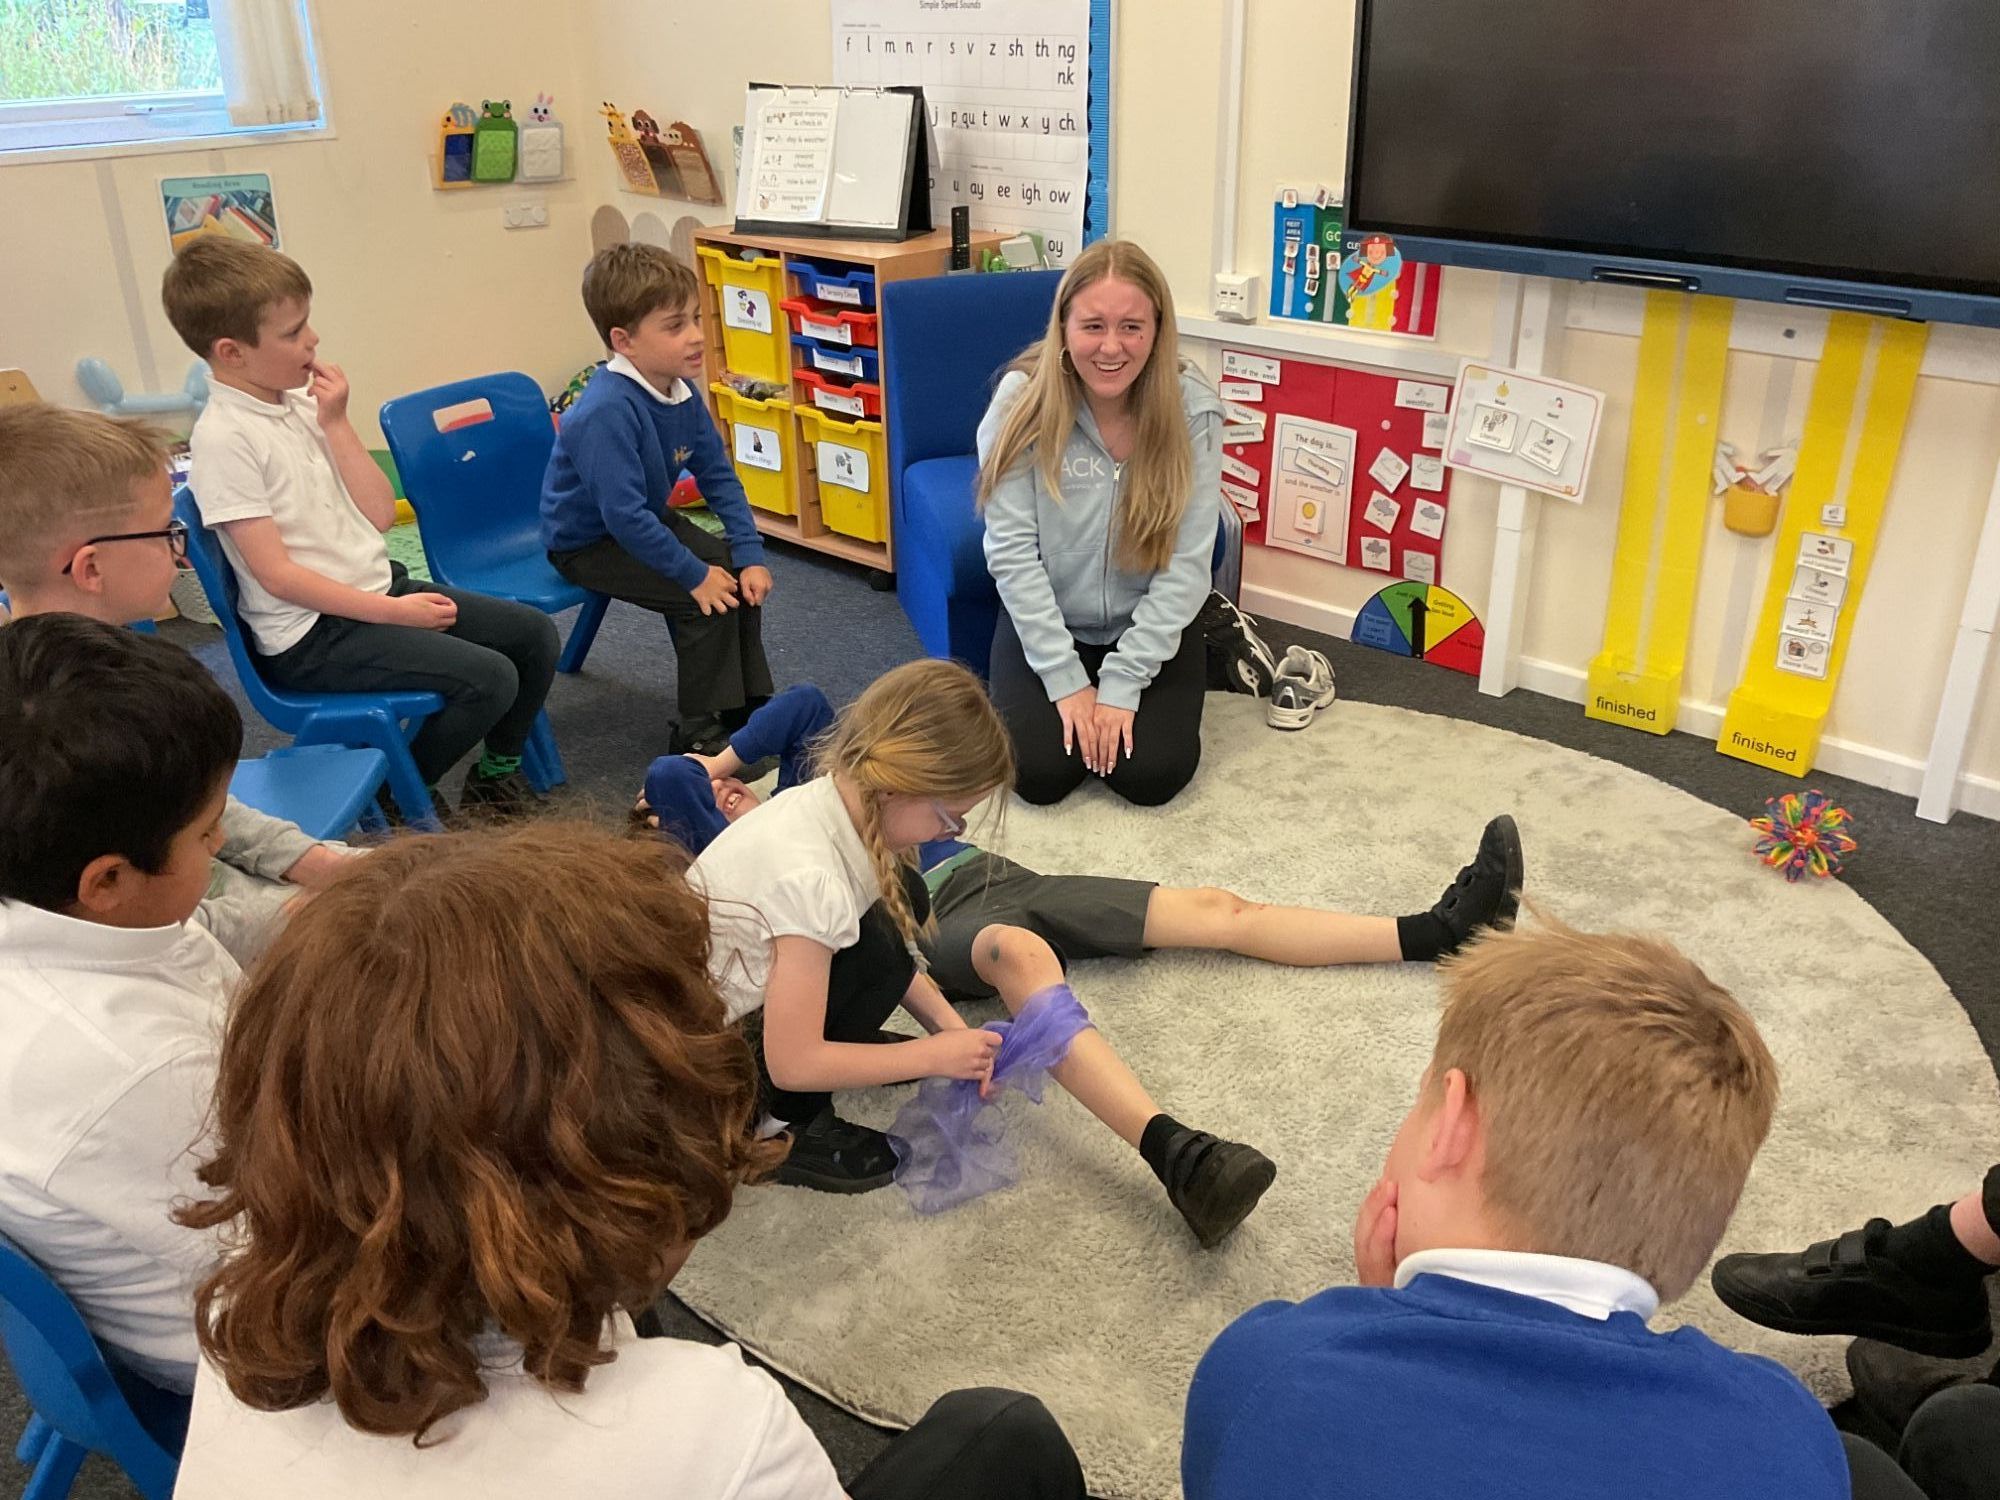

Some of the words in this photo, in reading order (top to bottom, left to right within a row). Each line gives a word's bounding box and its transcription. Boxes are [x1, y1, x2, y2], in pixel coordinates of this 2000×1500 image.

[846, 36, 851, 52] f
[886, 41, 896, 53] m
[906, 41, 913, 54] n
[928, 42, 933, 54] r
[950, 41, 955, 54] s
[967, 42, 975, 55] v
[990, 42, 996, 56] z
[1009, 38, 1024, 57] sh
[1036, 38, 1049, 57] th
[1058, 43, 1076, 63] ng
[1058, 66, 1074, 85] nk
[932, 106, 938, 127] j
[951, 111, 957, 127] p
[962, 112, 975, 129] qu
[982, 111, 988, 126] t
[999, 114, 1010, 127] w
[1021, 116, 1029, 128] x
[1042, 118, 1050, 134] y
[1059, 113, 1076, 131] ch
[953, 180, 959, 192] u
[970, 182, 984, 200] ay
[997, 185, 1010, 198] ee
[1022, 183, 1041, 205] igh
[1050, 190, 1071, 203] ow
[1048, 239, 1063, 257] oy
[1295, 434, 1308, 443] The
[1310, 437, 1324, 449] day
[1299, 479, 1309, 488] the
[1310, 483, 1333, 494] weather
[1433, 599, 1455, 610] Getting
[1596, 696, 1656, 721] finished
[1732, 732, 1797, 761] finished
